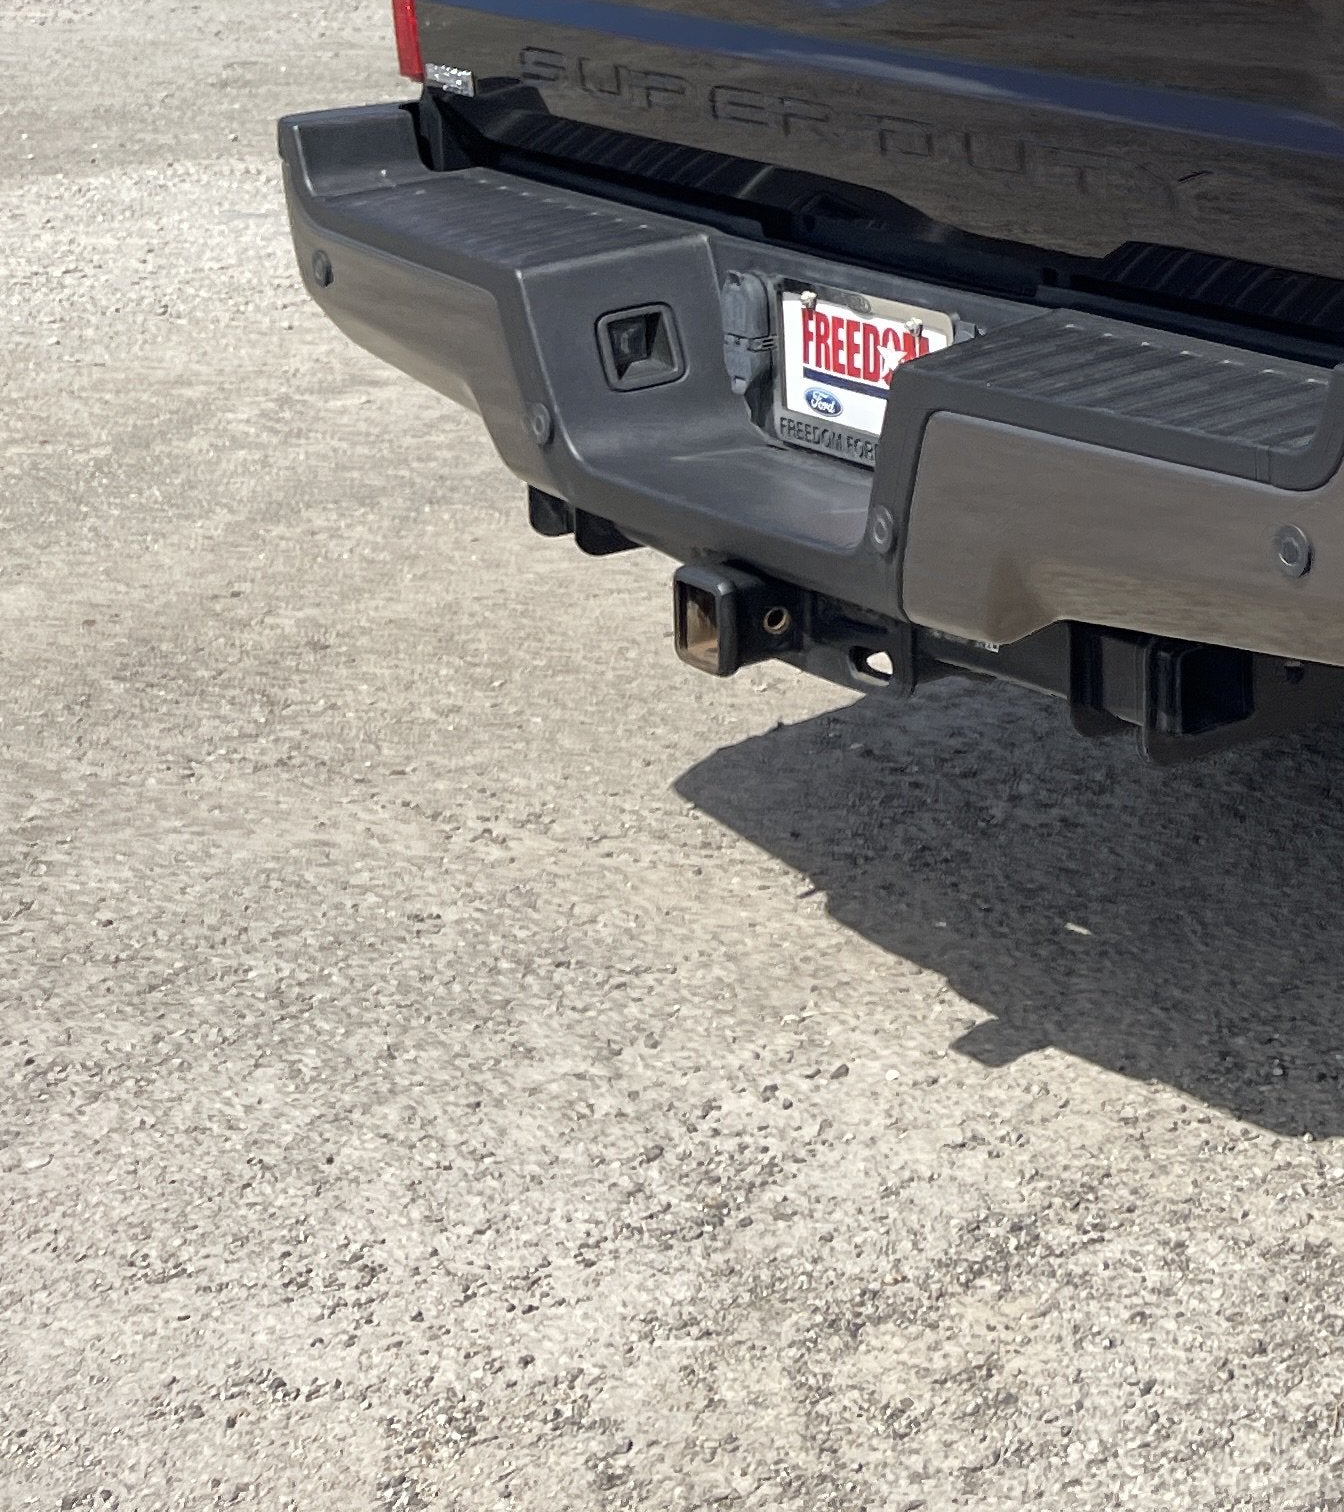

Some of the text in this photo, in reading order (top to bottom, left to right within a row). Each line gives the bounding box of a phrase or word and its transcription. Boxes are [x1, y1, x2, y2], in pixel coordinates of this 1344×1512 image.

[519, 45, 1213, 211] SUPER DUTY
[810, 392, 837, 415] Ford
[780, 416, 878, 460] FREEDOM FOR
